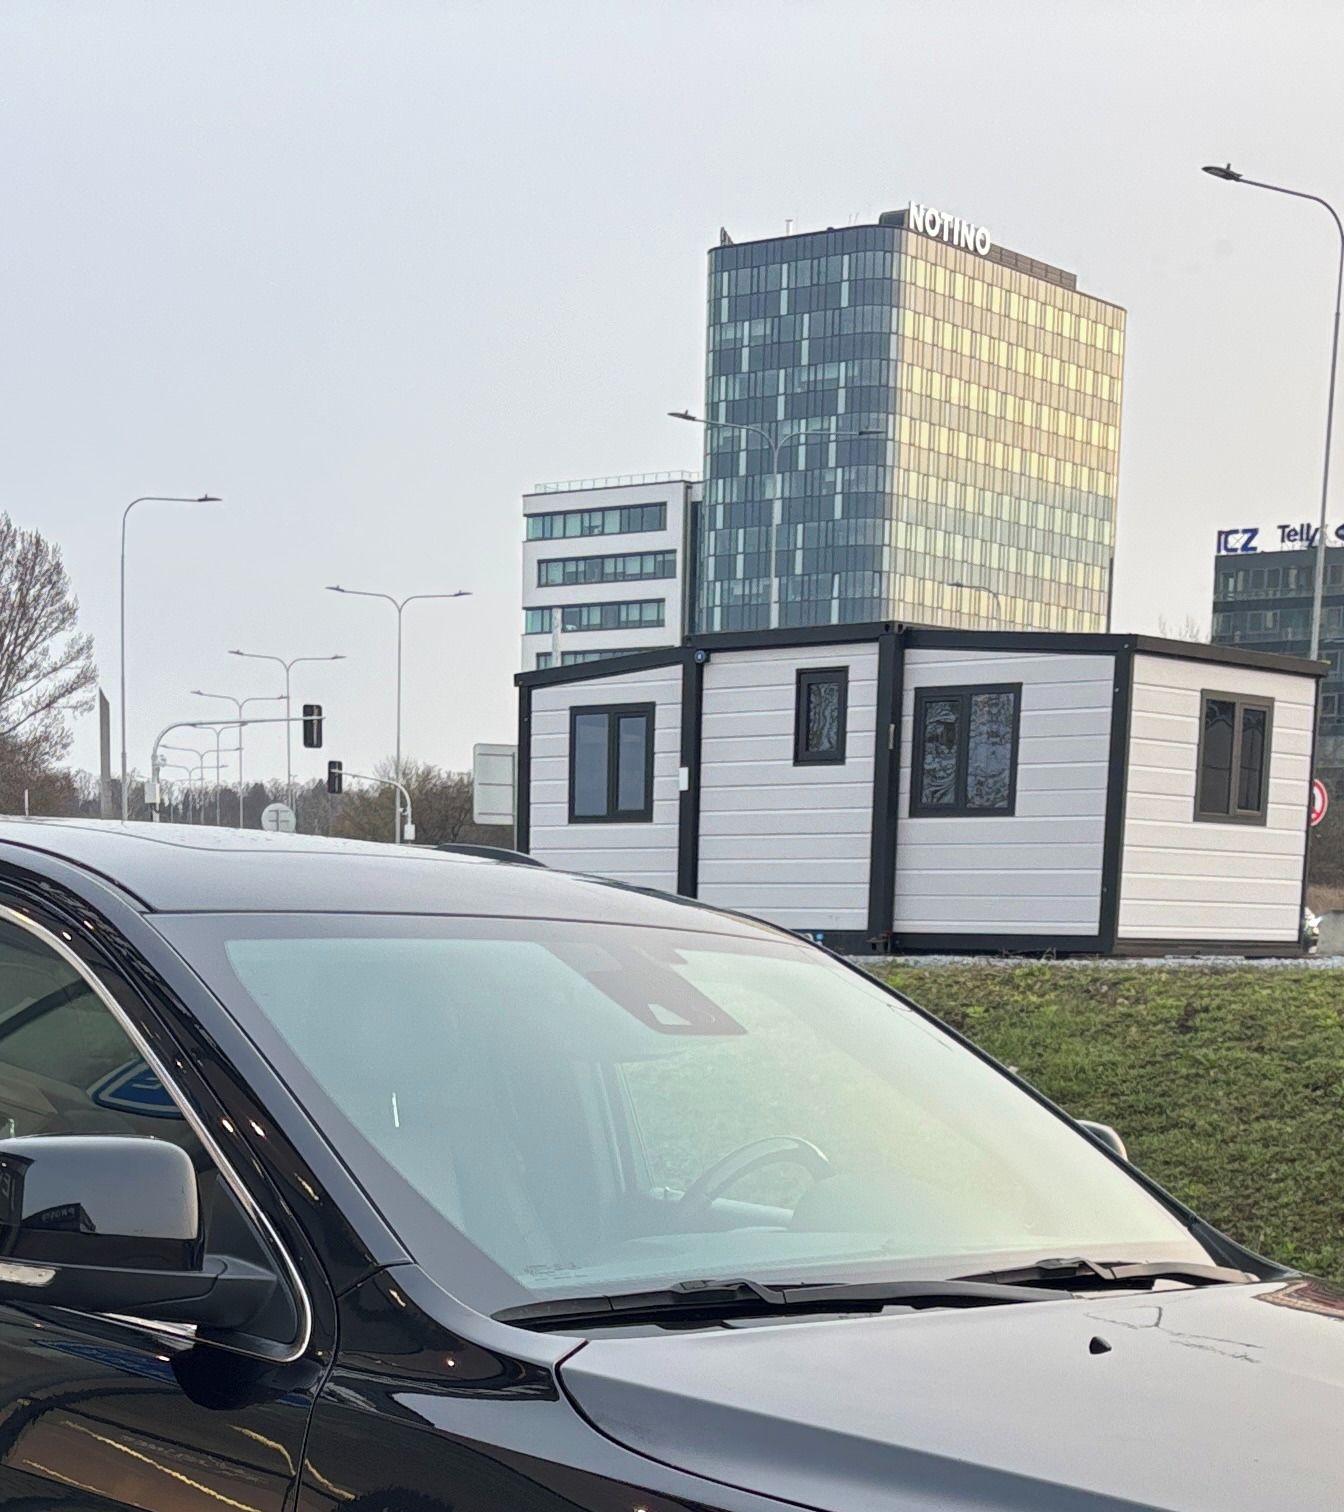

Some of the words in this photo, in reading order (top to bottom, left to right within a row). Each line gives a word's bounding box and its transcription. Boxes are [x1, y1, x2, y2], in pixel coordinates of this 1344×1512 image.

[908, 200, 992, 256] NOTINO
[1217, 527, 1259, 554] ICZ
[1277, 522, 1320, 550] Telly
